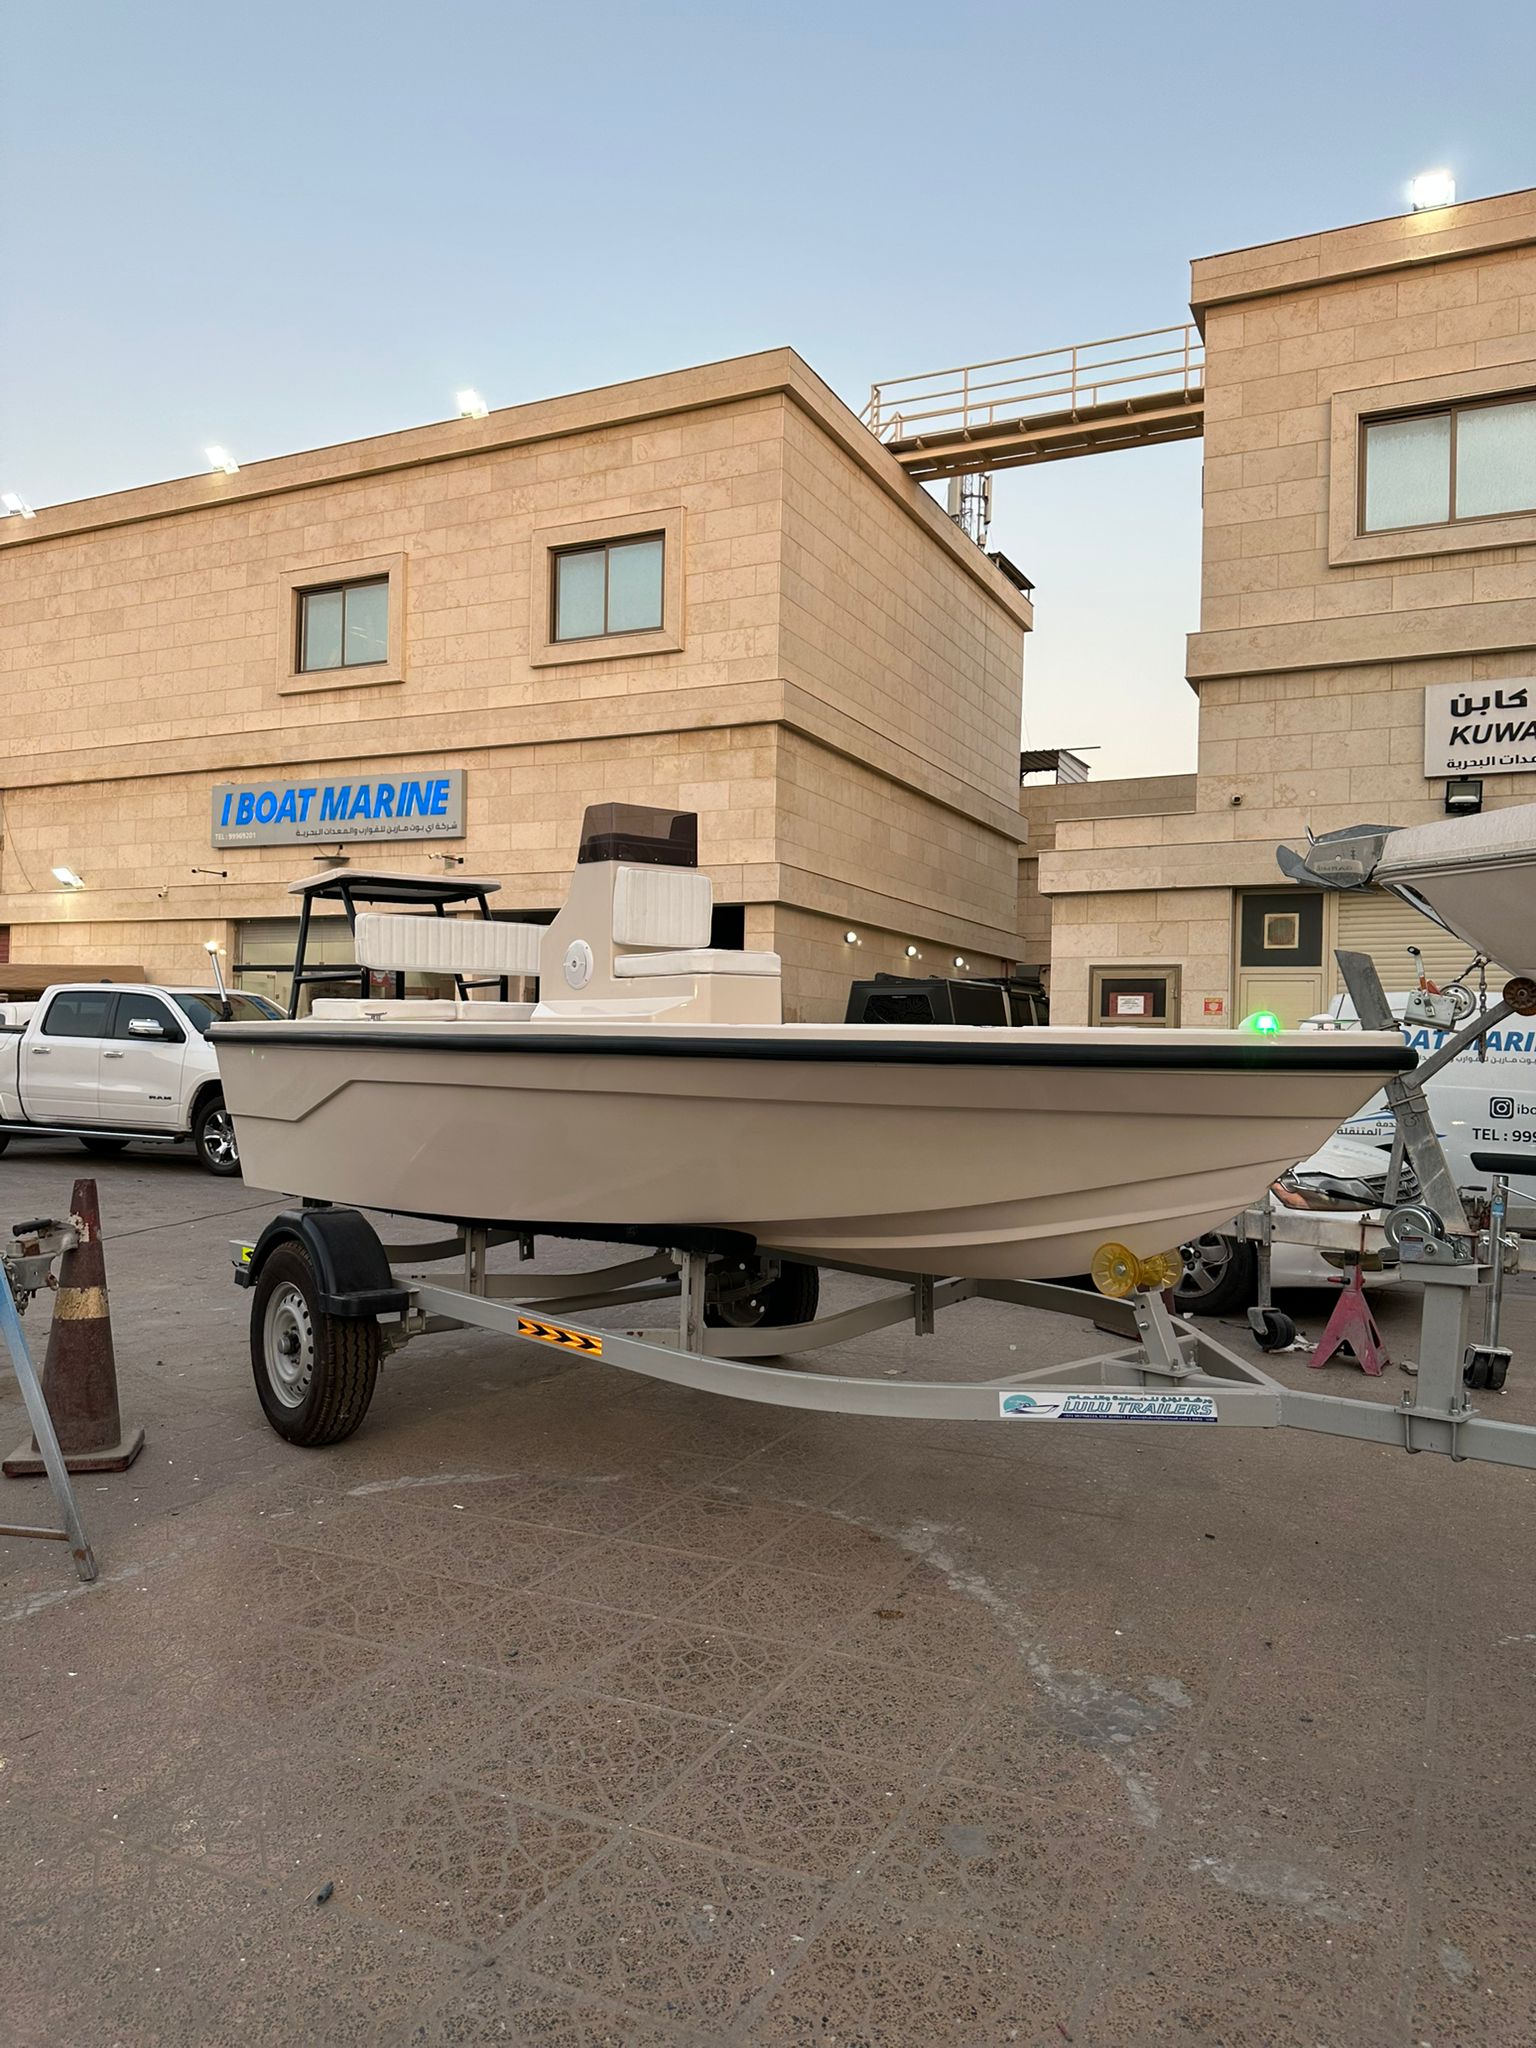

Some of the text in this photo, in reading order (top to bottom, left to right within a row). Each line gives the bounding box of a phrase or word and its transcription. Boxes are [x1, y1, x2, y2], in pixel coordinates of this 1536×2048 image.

[1446, 756, 1496, 770] البحرية
[221, 779, 450, 827] I BOAT MARINE
[1472, 1128, 1500, 1141] TEL
[1063, 1400, 1213, 1416] LULU TRAILERS
